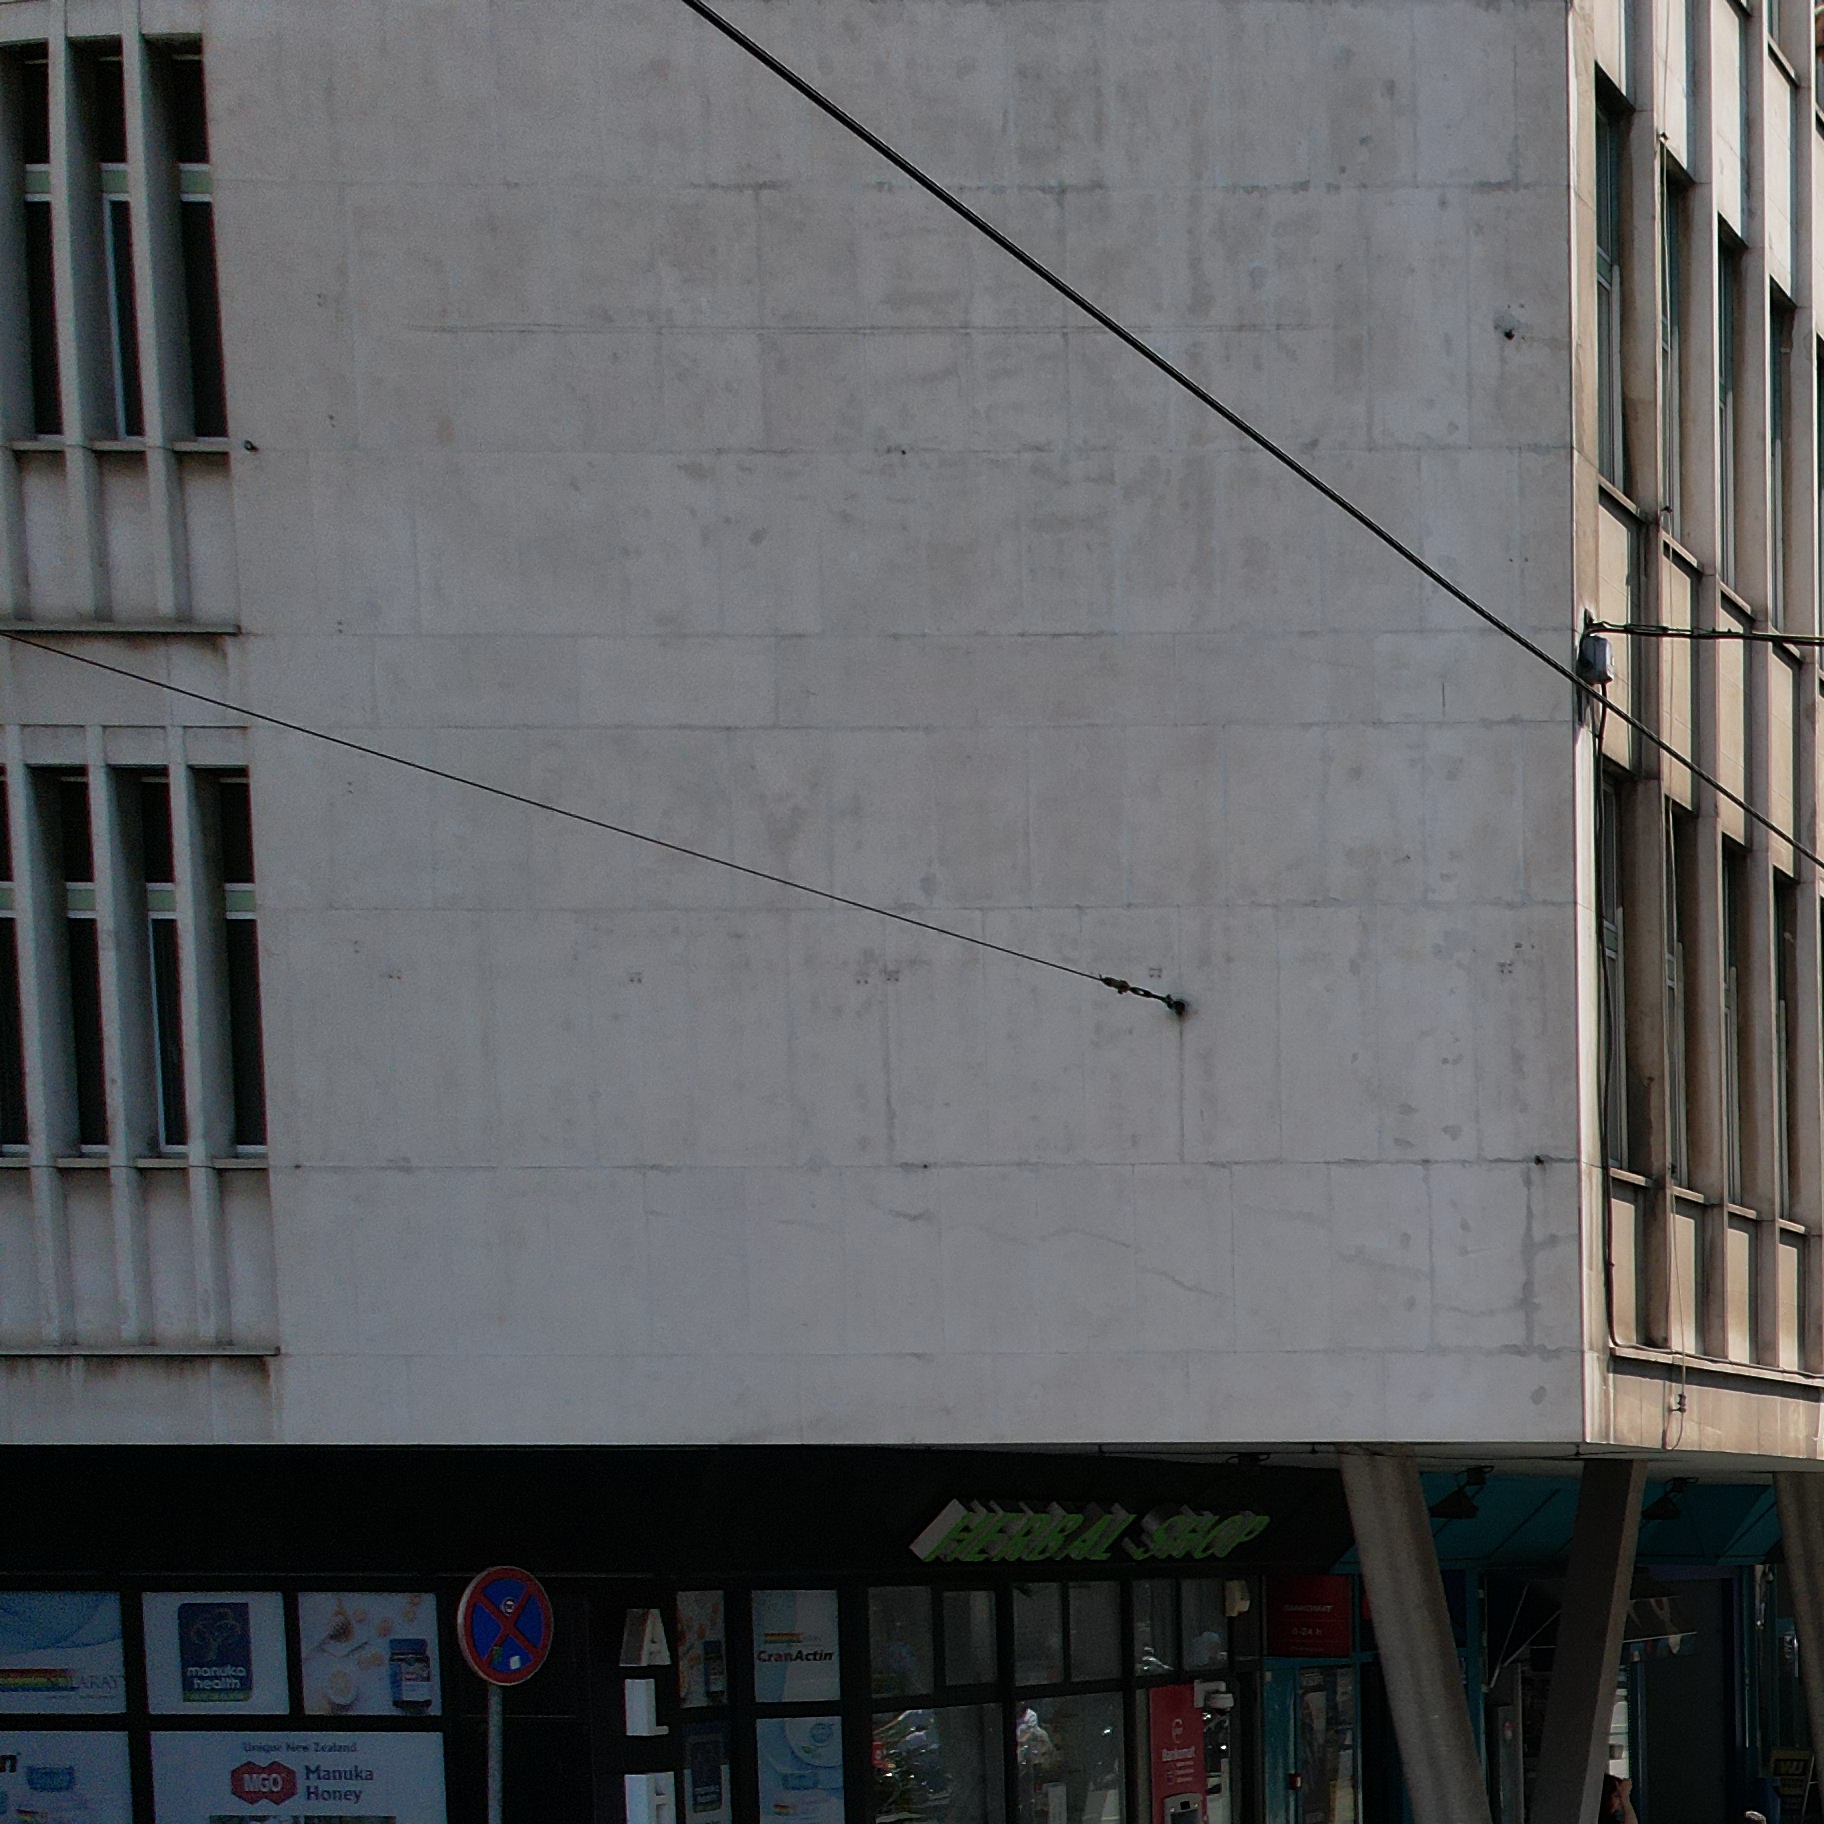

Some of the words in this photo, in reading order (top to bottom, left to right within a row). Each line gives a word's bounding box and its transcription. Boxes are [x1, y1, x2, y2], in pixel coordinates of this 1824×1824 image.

[921, 1510, 1138, 1563] HERBAL
[1130, 1514, 1271, 1561] SHOP
[757, 1650, 833, 1662] CranActin
[187, 1665, 246, 1677] manuka
[193, 1677, 241, 1690] health
[304, 1765, 374, 1781] Manuka
[243, 1773, 282, 1792] MGO
[306, 1785, 363, 1804] Honey
